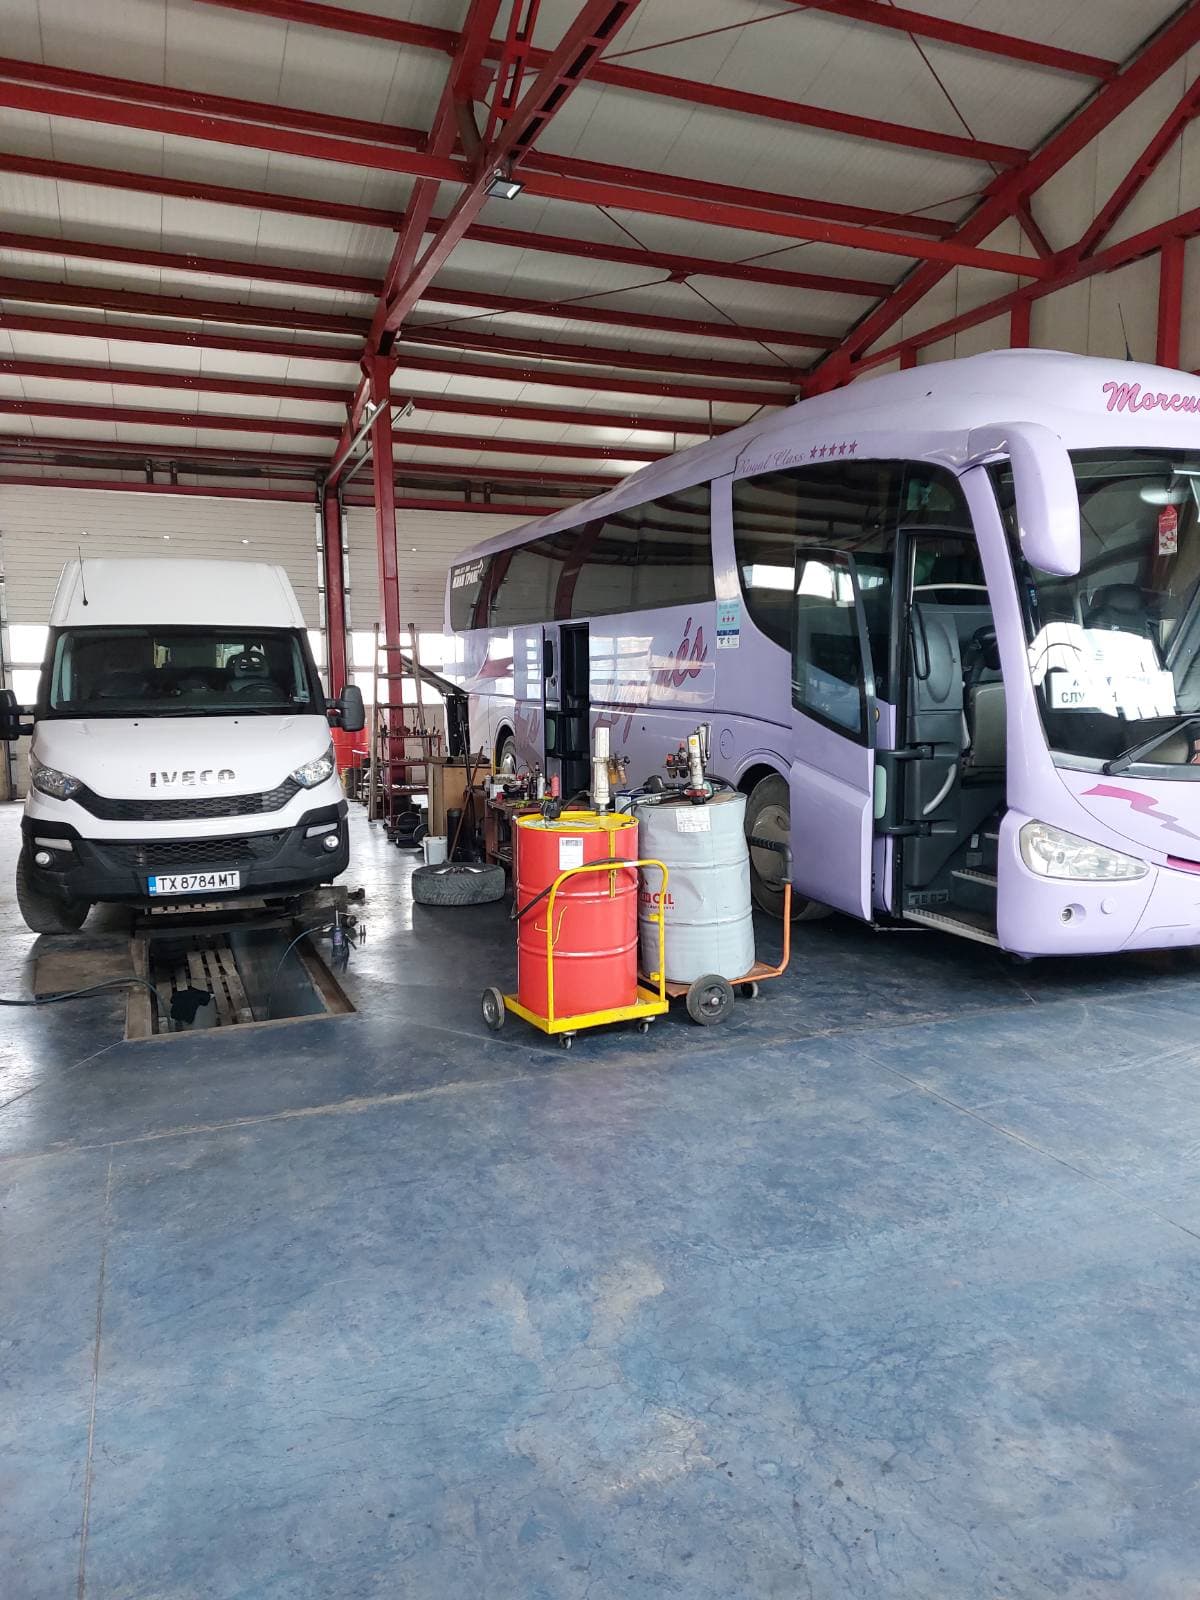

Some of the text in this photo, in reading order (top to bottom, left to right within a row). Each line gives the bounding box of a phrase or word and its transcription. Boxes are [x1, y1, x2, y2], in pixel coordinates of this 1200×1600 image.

[1102, 381, 1200, 413] Morcu
[773, 448, 803, 467] Class
[150, 769, 236, 788] IVECO
[181, 875, 215, 889] 8784
